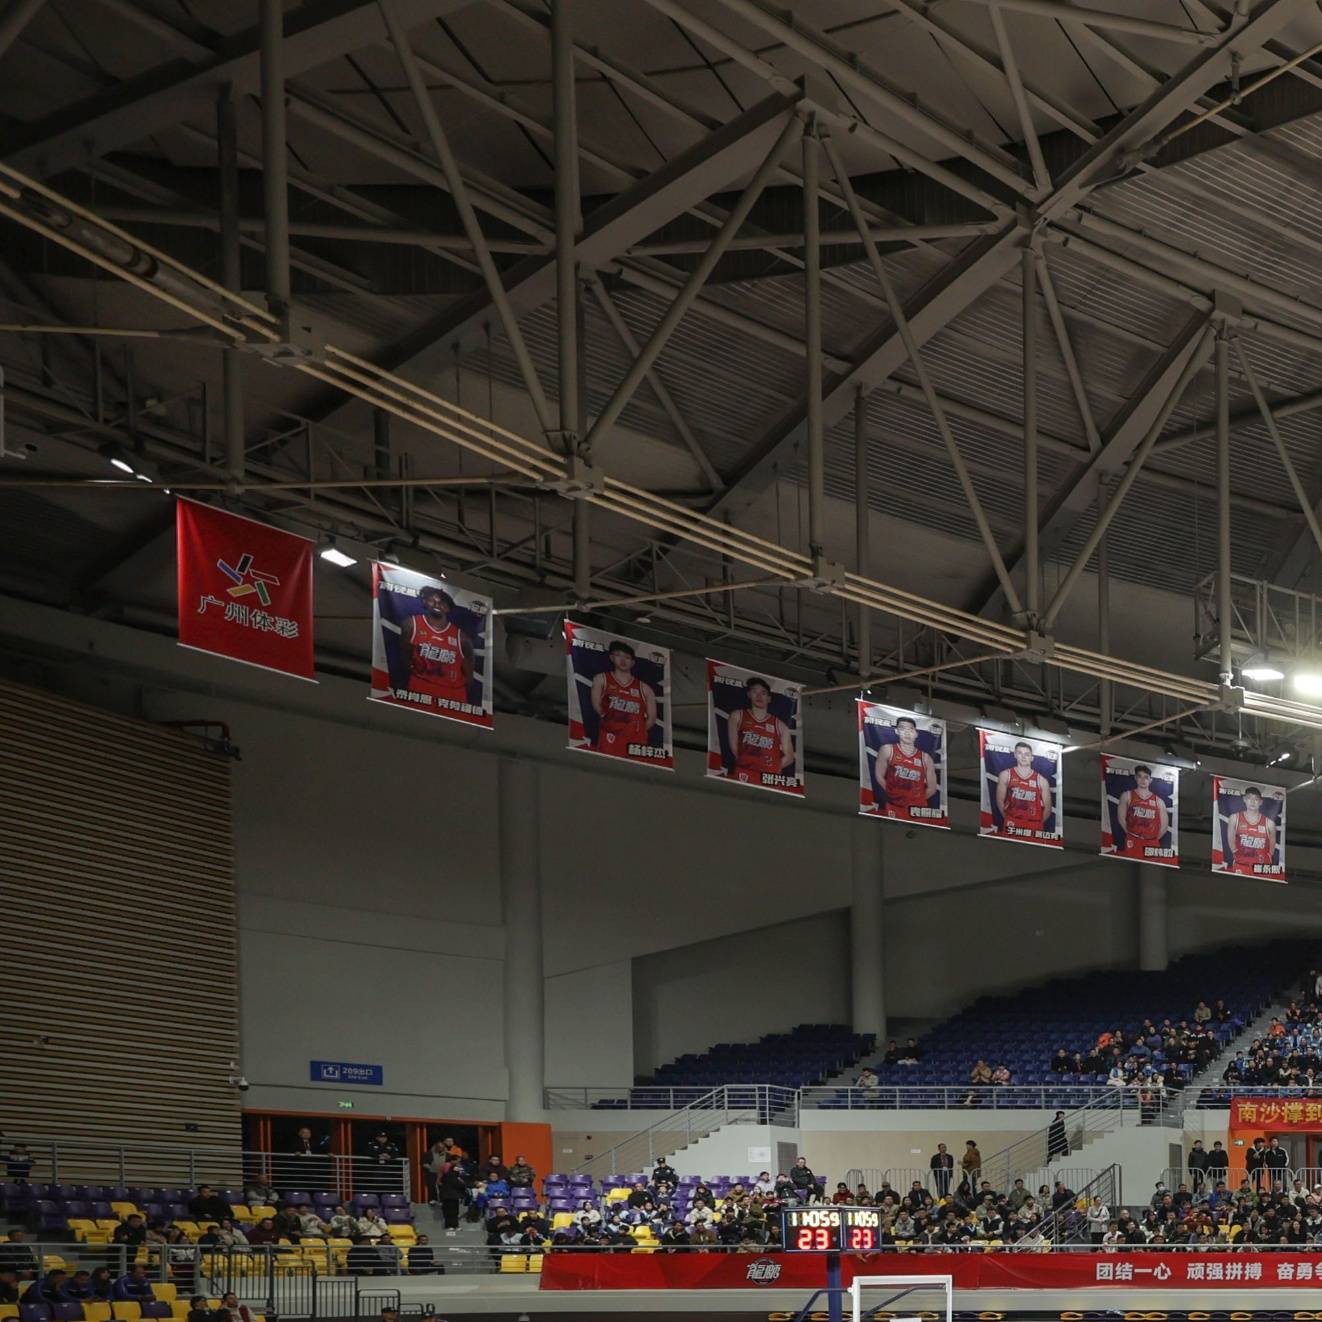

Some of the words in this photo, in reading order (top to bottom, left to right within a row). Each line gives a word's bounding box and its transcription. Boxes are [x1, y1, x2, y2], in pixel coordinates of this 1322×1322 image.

[197, 594, 299, 639] 广州体彩
[798, 1228, 829, 1249] 23
[852, 1229, 873, 1249] 23
[1096, 1262, 1172, 1282] 团结一心
[1187, 1262, 1263, 1282] 顽强拼搏
